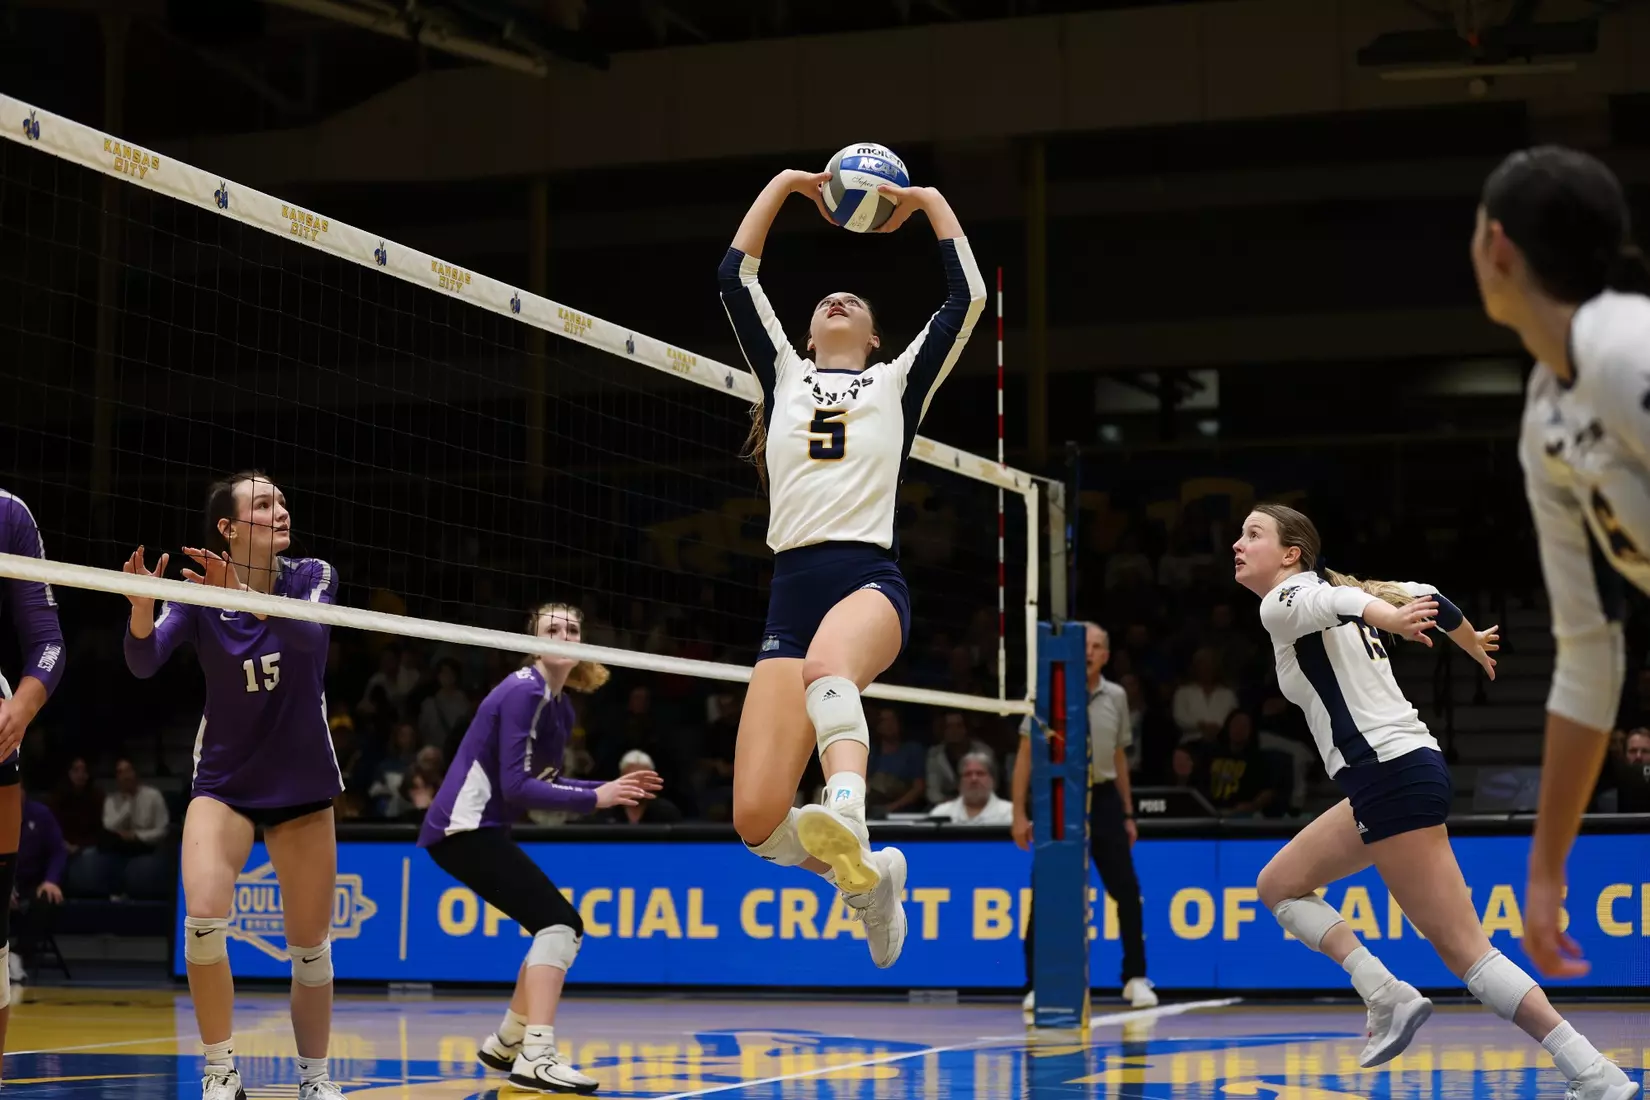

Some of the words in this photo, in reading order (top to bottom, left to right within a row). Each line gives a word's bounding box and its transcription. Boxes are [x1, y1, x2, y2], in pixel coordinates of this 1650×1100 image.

[103, 137, 160, 171] KANSAS
[113, 156, 149, 180] CITY
[281, 204, 329, 233] KANSAS
[290, 221, 319, 242] CITY
[431, 260, 472, 285] KANSAS
[438, 275, 464, 294] CITY
[808, 408, 849, 462] 5
[243, 651, 281, 693] 15
[739, 887, 950, 940] CRAT
[1168, 886, 1259, 940] OF
